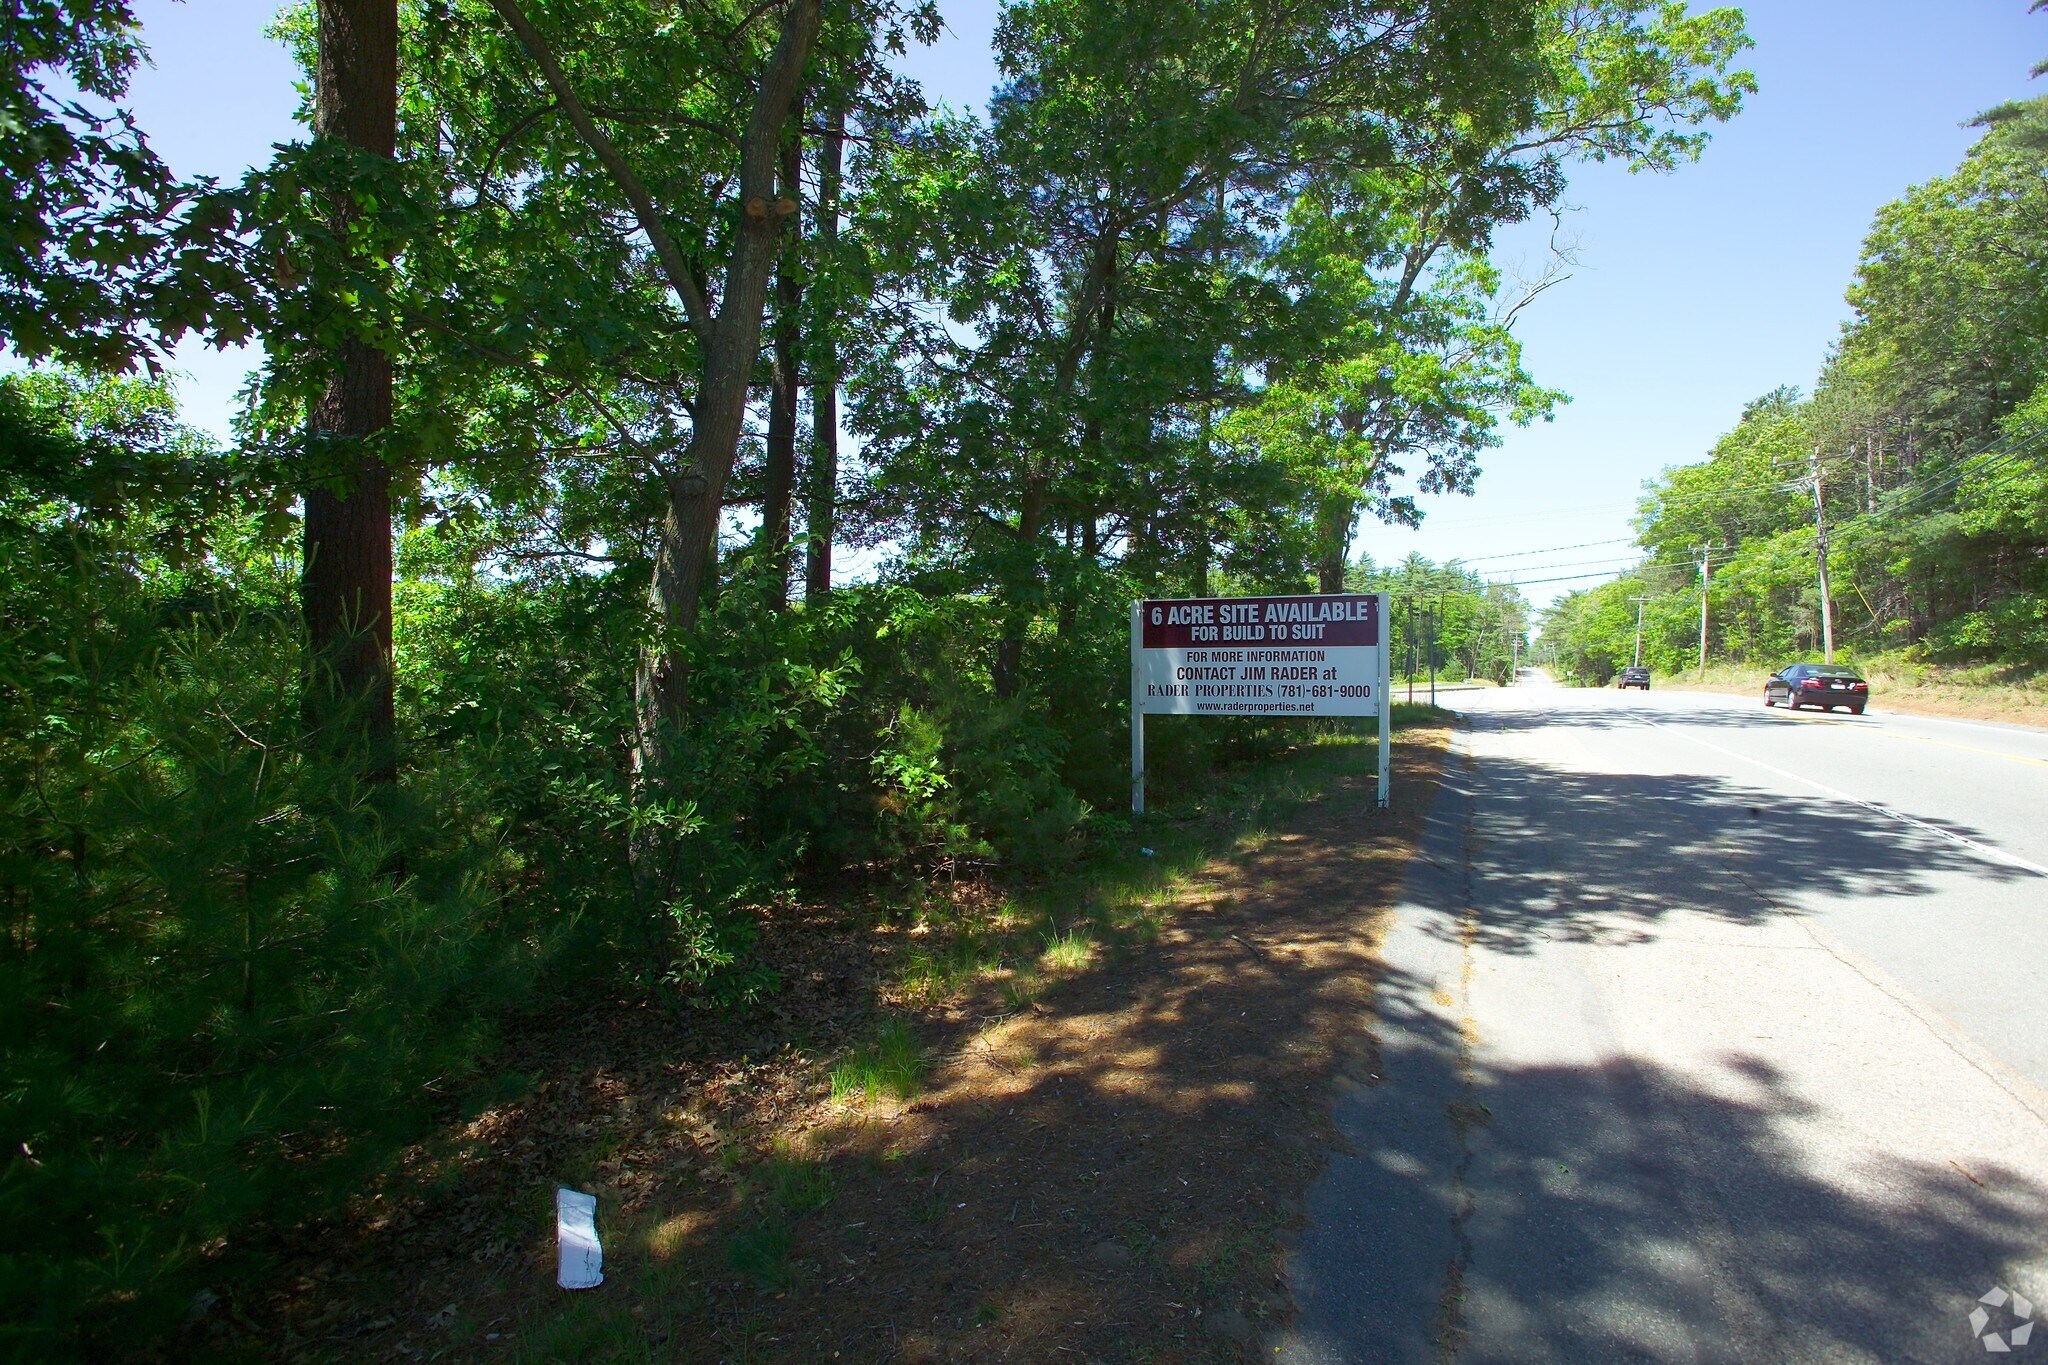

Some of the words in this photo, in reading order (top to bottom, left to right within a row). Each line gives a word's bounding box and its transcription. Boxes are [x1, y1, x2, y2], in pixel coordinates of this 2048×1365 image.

[1152, 607, 1162, 625] 6
[1168, 605, 1214, 624] ACRE
[1219, 604, 1259, 623] SITE
[1265, 602, 1368, 623] AVAILABLE
[1191, 626, 1219, 641] FOR
[1223, 625, 1264, 640] BUILD
[1269, 625, 1288, 640] TO
[1292, 624, 1325, 639] SUIT
[1187, 652, 1207, 662] FOR
[1212, 651, 1243, 662] MORE
[1247, 651, 1325, 662] INFORMATION
[1177, 667, 1236, 680] CONTACT
[1241, 667, 1265, 680] JIM
[1271, 667, 1317, 680] RADER
[1323, 667, 1337, 680] at
[1148, 685, 1189, 697] RADER
[1195, 685, 1273, 697] PROPERTIES
[1277, 685, 1371, 698] (781)-681-9000
[1197, 702, 1314, 712] www.raderproperties.net
